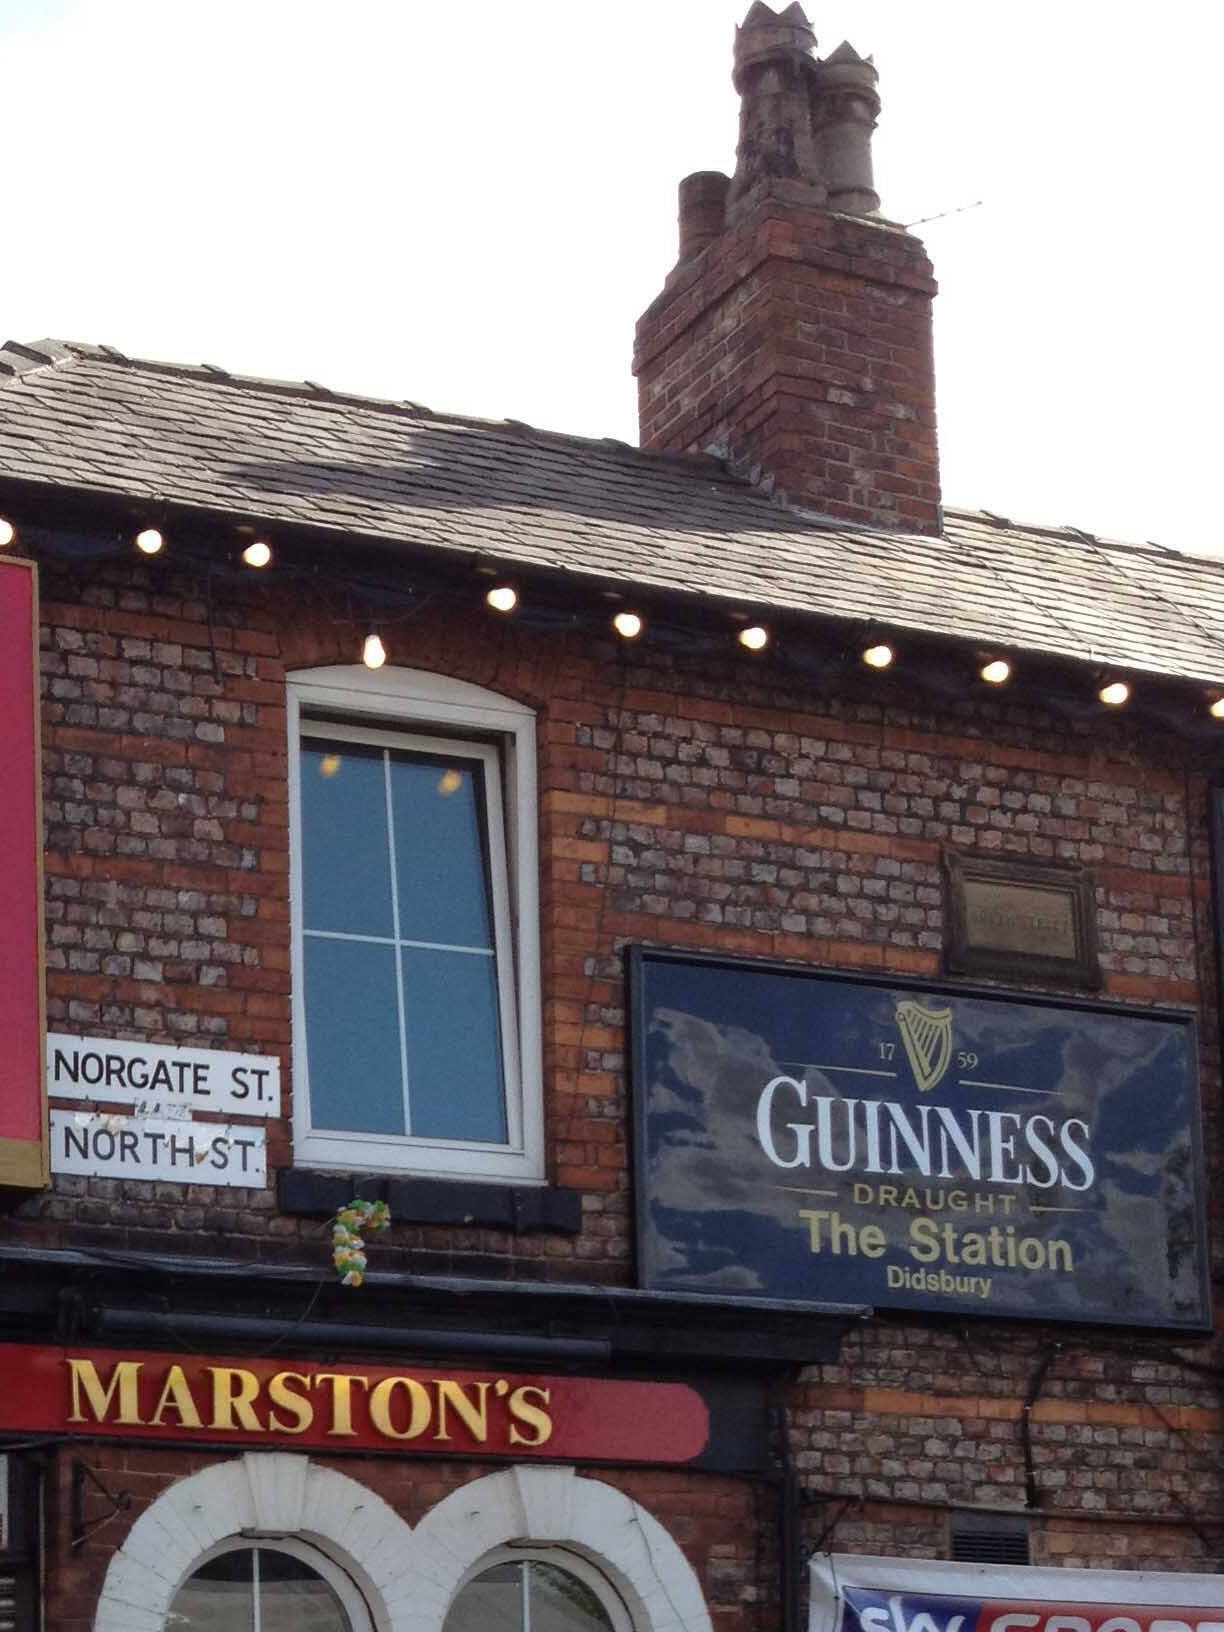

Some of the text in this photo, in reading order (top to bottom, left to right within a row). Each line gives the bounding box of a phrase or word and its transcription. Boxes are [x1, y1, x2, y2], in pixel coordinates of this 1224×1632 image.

[54, 1048, 274, 1102] NORGATE ST.
[879, 1043, 979, 1071] 17 59
[64, 1125, 261, 1173] NORTH ST.
[756, 1075, 1096, 1192] GUINNESS
[853, 1183, 1017, 1215] DRAUGHT
[799, 1209, 1074, 1272] The Station
[887, 1265, 993, 1299] Didsbury
[66, 1358, 553, 1447] MARSTON'S
